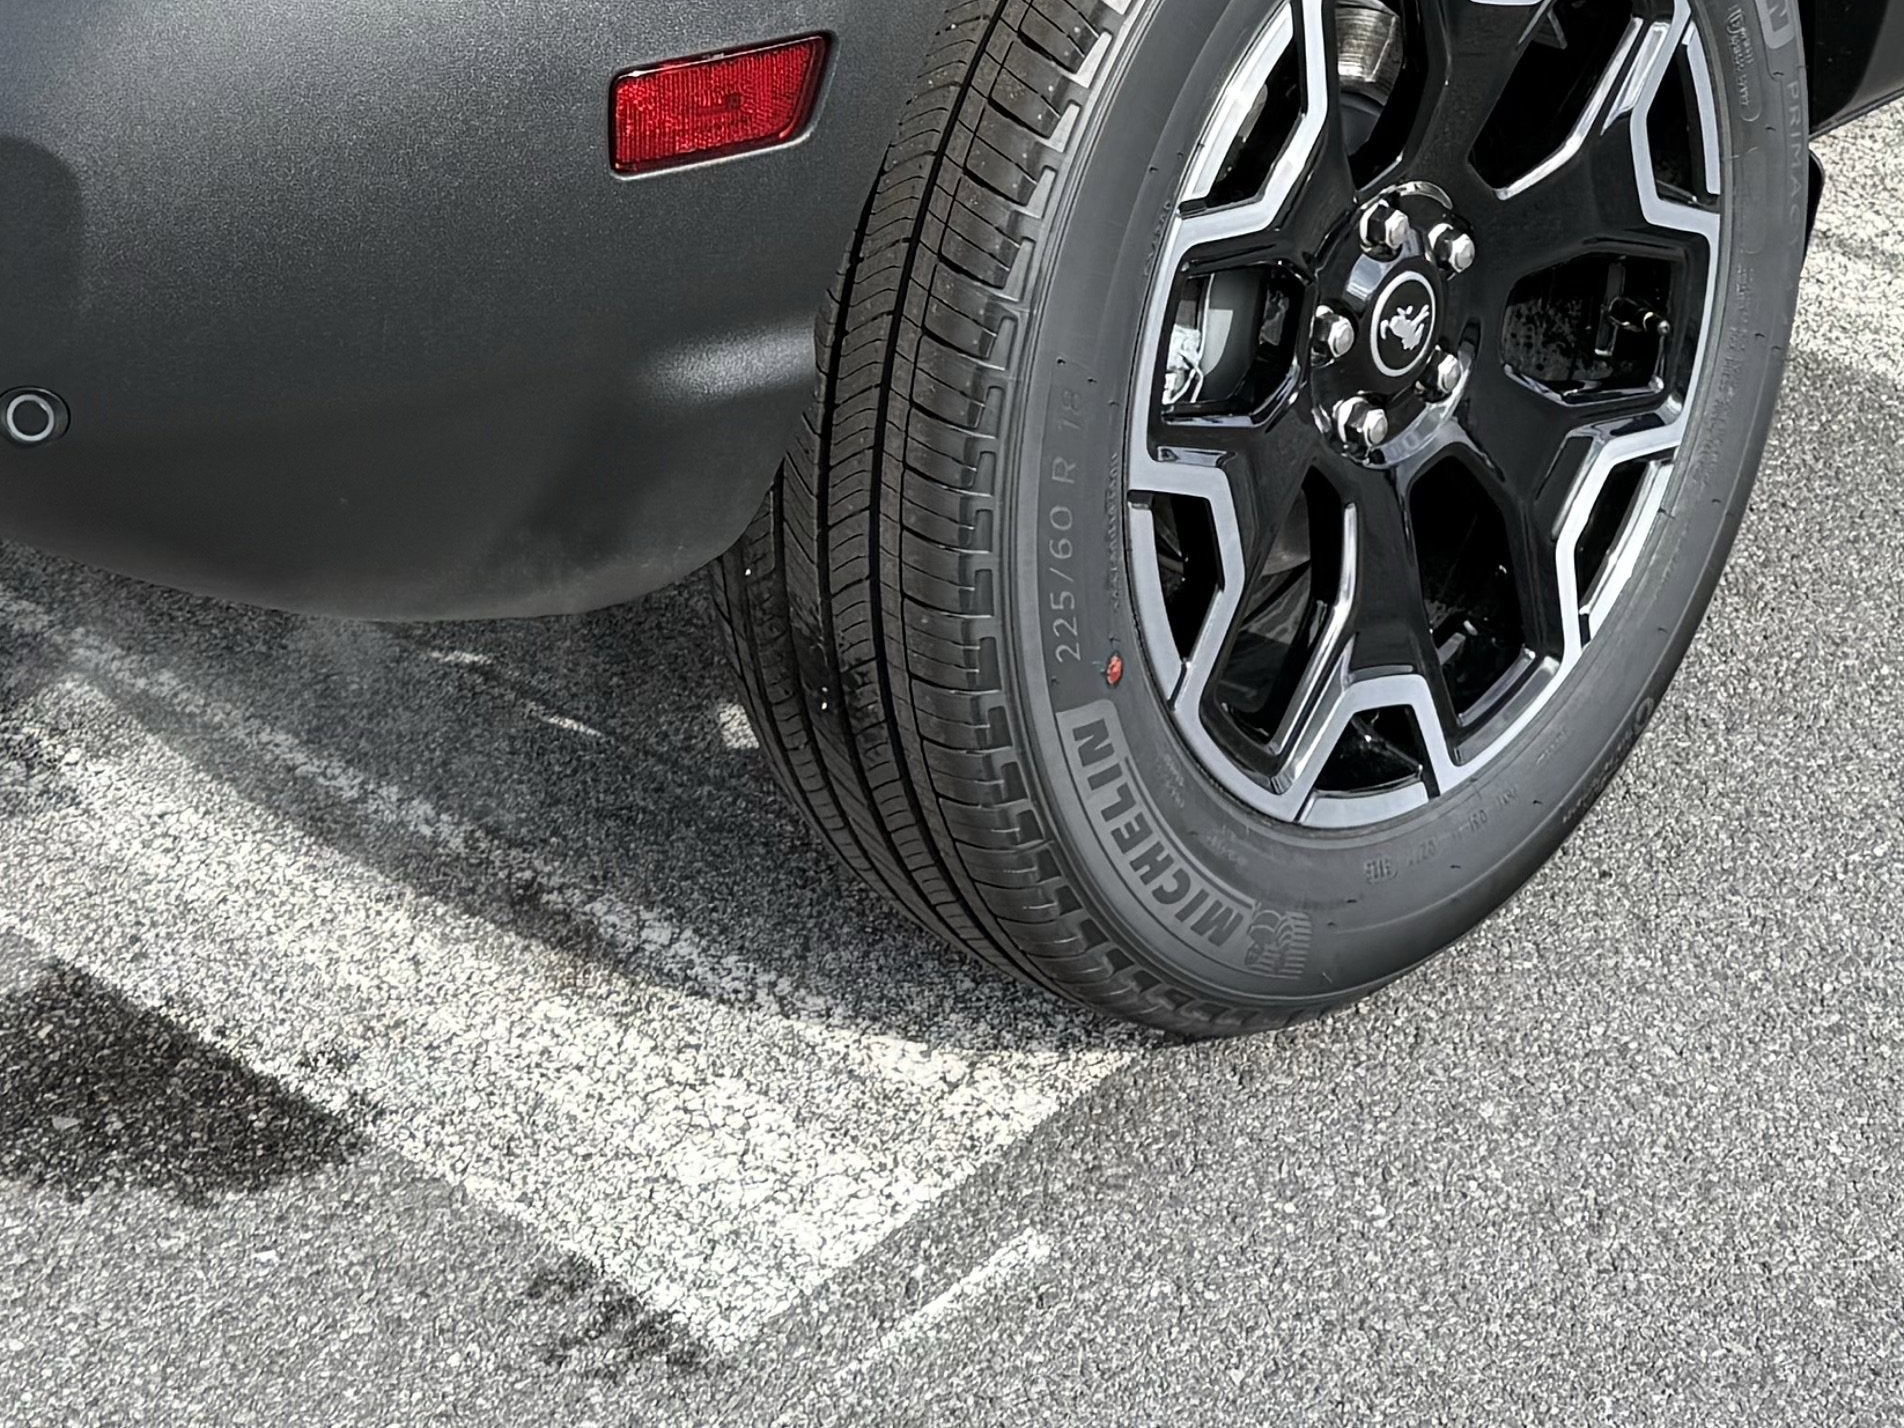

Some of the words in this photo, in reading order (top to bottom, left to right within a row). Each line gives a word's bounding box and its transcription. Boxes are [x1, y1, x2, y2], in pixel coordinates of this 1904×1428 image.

[1050, 455, 1078, 485] R
[1048, 504, 1082, 663] 225/60
[1072, 716, 1246, 947] MICHELIN
